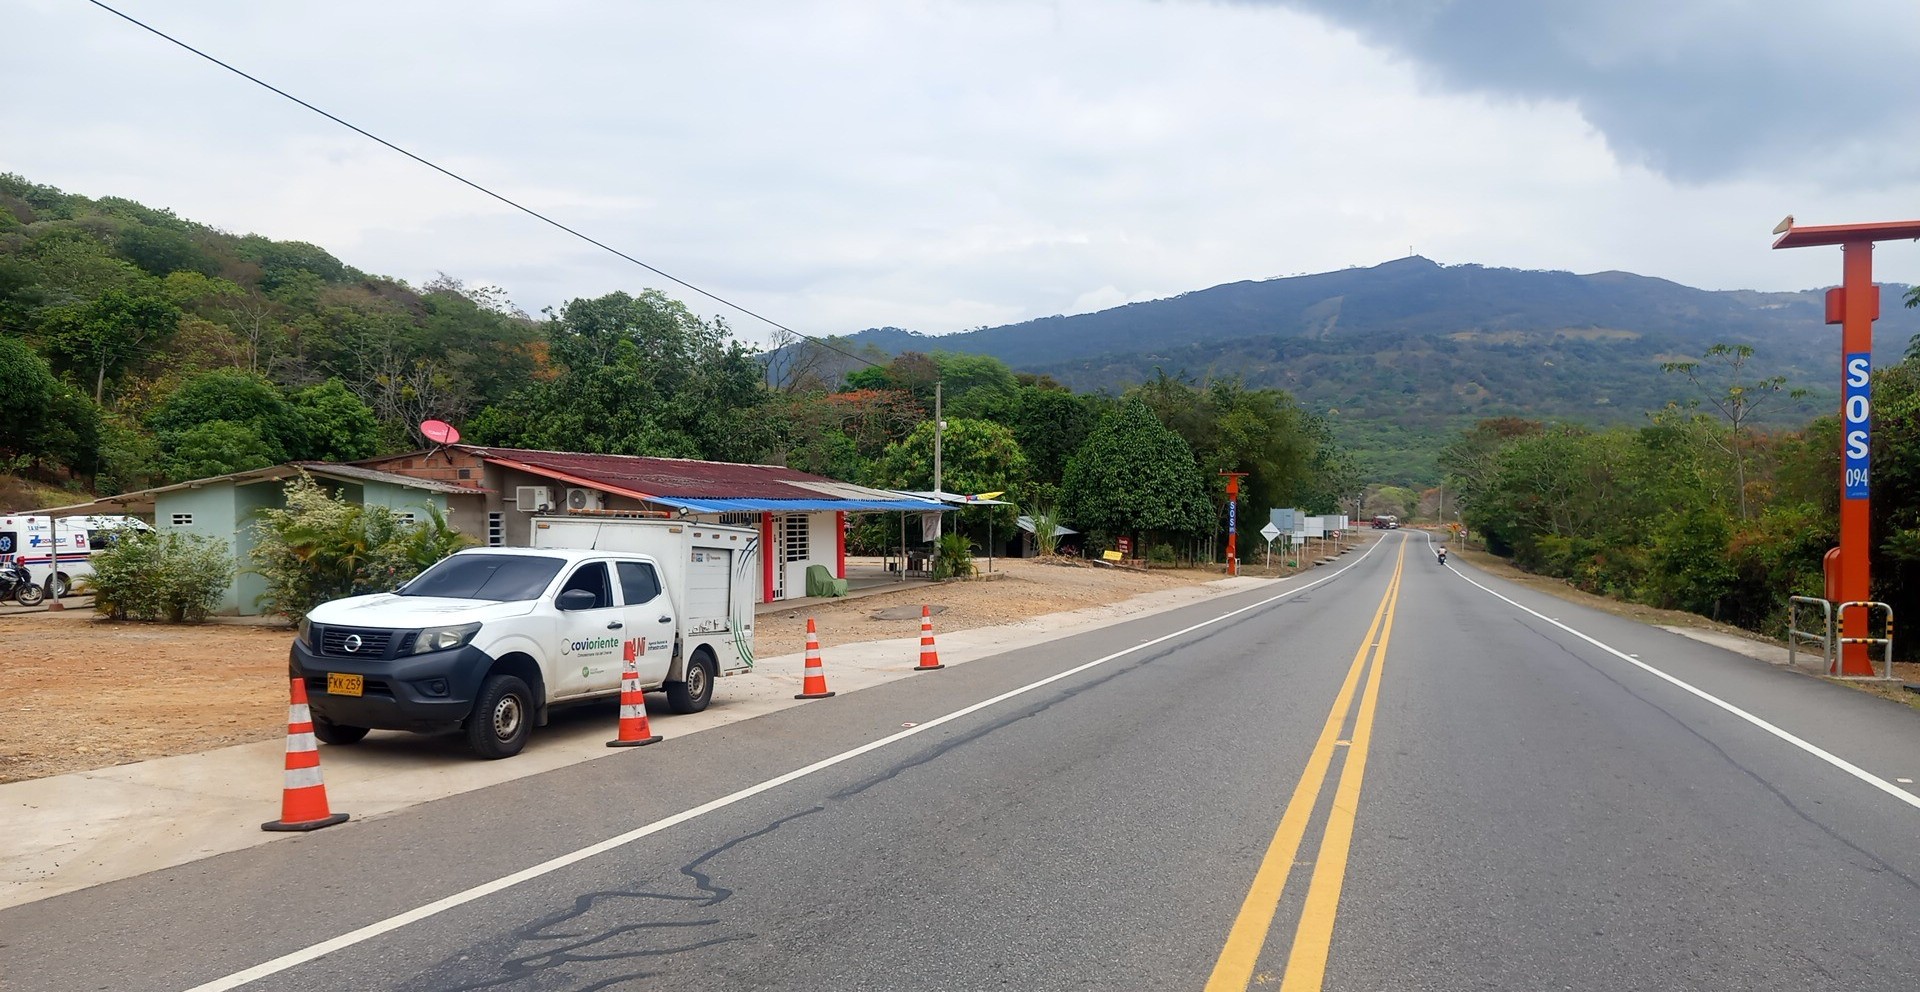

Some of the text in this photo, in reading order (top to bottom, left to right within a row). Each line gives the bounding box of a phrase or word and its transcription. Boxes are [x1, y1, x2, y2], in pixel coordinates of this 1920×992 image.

[1846, 358, 1869, 459] SOS
[1846, 468, 1869, 487] 094
[571, 637, 619, 651] covioriente
[329, 676, 361, 690] FKK 259
